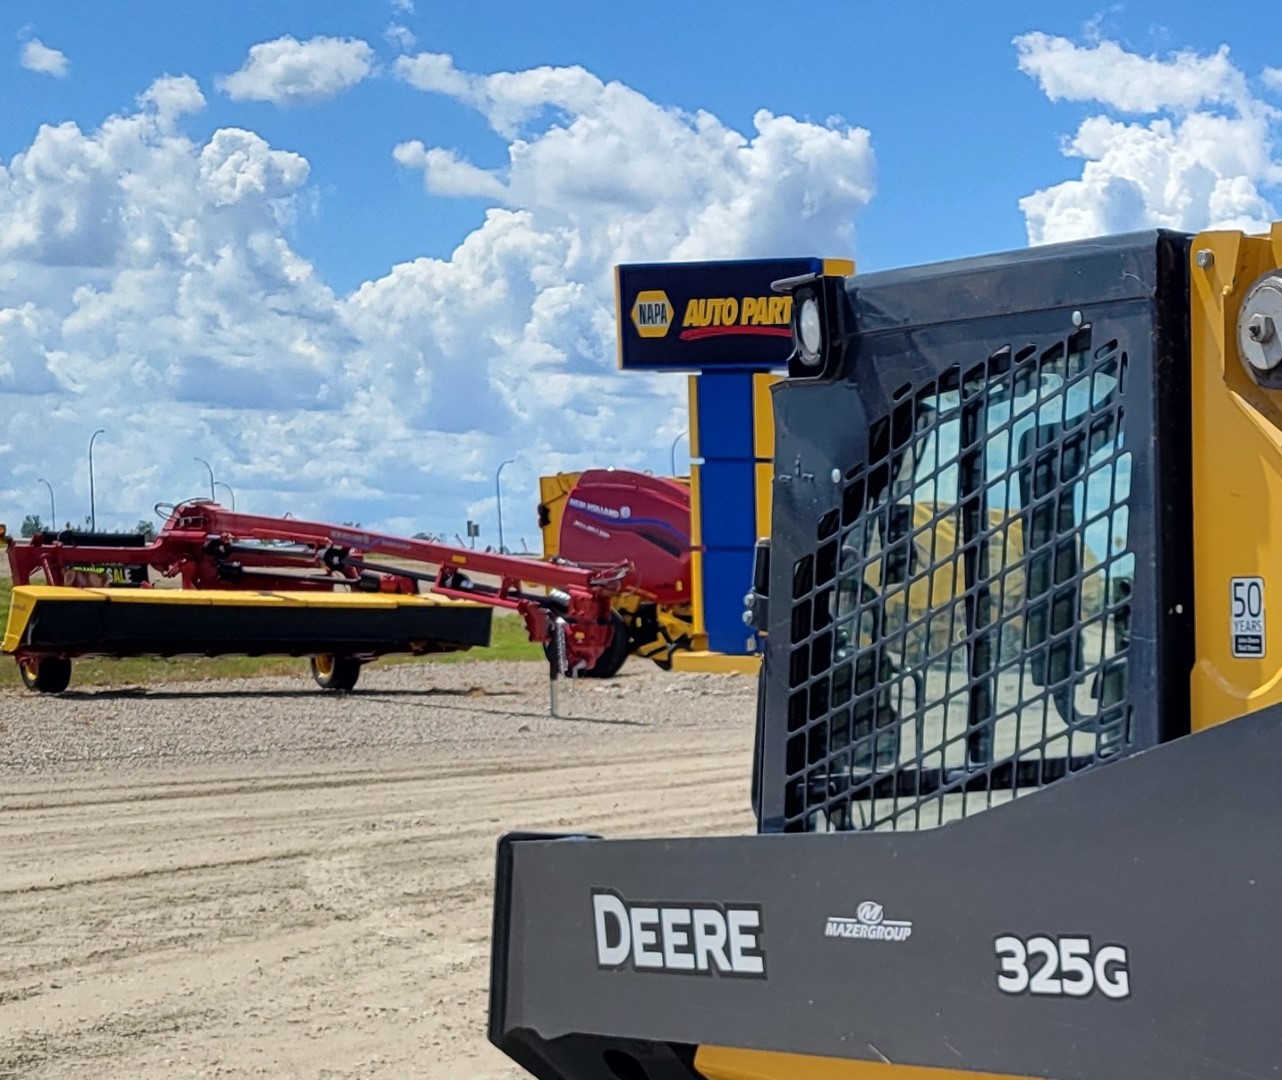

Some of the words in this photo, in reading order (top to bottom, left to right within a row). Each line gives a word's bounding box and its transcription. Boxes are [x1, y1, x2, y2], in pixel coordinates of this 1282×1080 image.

[638, 303, 668, 325] NAPA
[683, 298, 739, 327] AUTO
[740, 296, 793, 326] PART
[105, 567, 132, 583] SALE
[1233, 581, 1262, 618] 50
[1233, 620, 1262, 632] YEARS
[593, 894, 764, 973] DEERE
[825, 924, 912, 941] MAZERGROUP
[995, 936, 1130, 998] 325G
